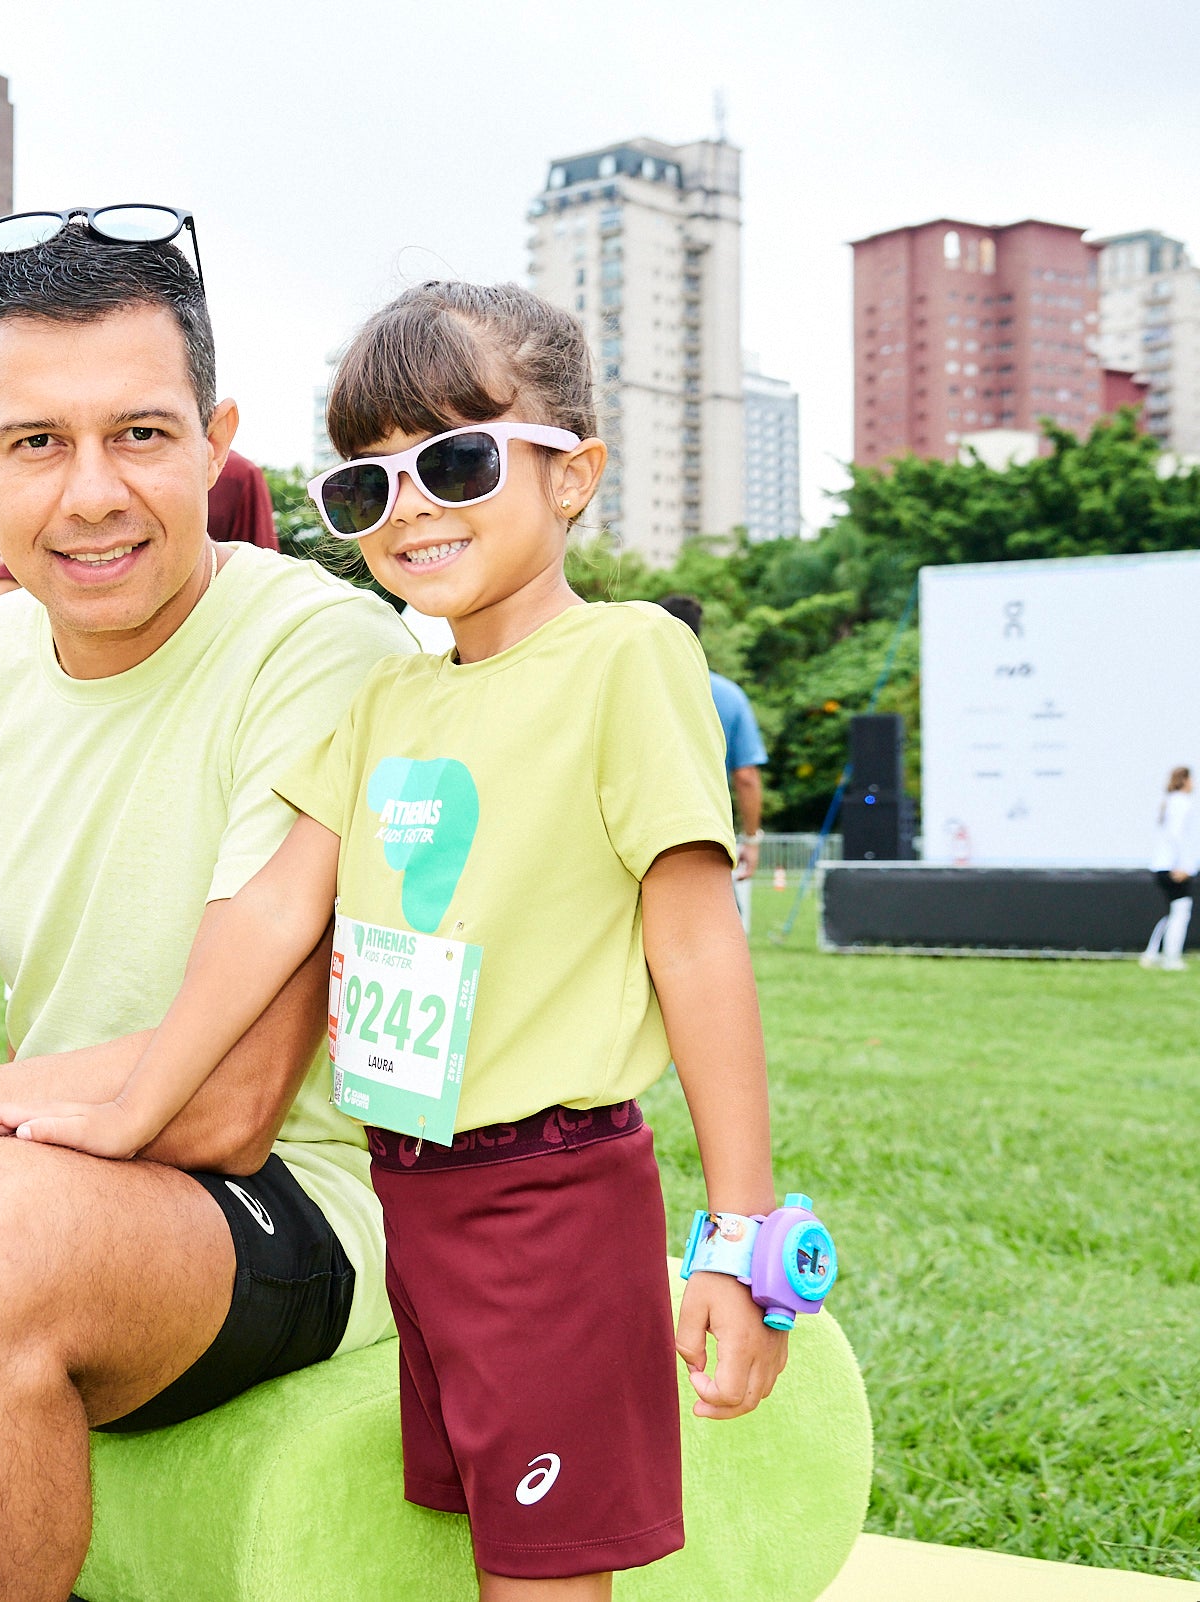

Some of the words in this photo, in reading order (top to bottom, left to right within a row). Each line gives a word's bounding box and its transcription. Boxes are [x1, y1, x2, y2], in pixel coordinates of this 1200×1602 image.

[379, 798, 443, 826] ATHENAS
[374, 826, 404, 843] KIDS
[402, 827, 435, 844] FASTER
[365, 927, 417, 956] ATHENAS
[364, 950, 380, 963] KIDS
[381, 953, 413, 970] FASTER
[459, 979, 471, 1009] 9242
[345, 975, 447, 1060] 9242
[368, 1054, 394, 1073] LAURA
[447, 1052, 459, 1082] 9242
